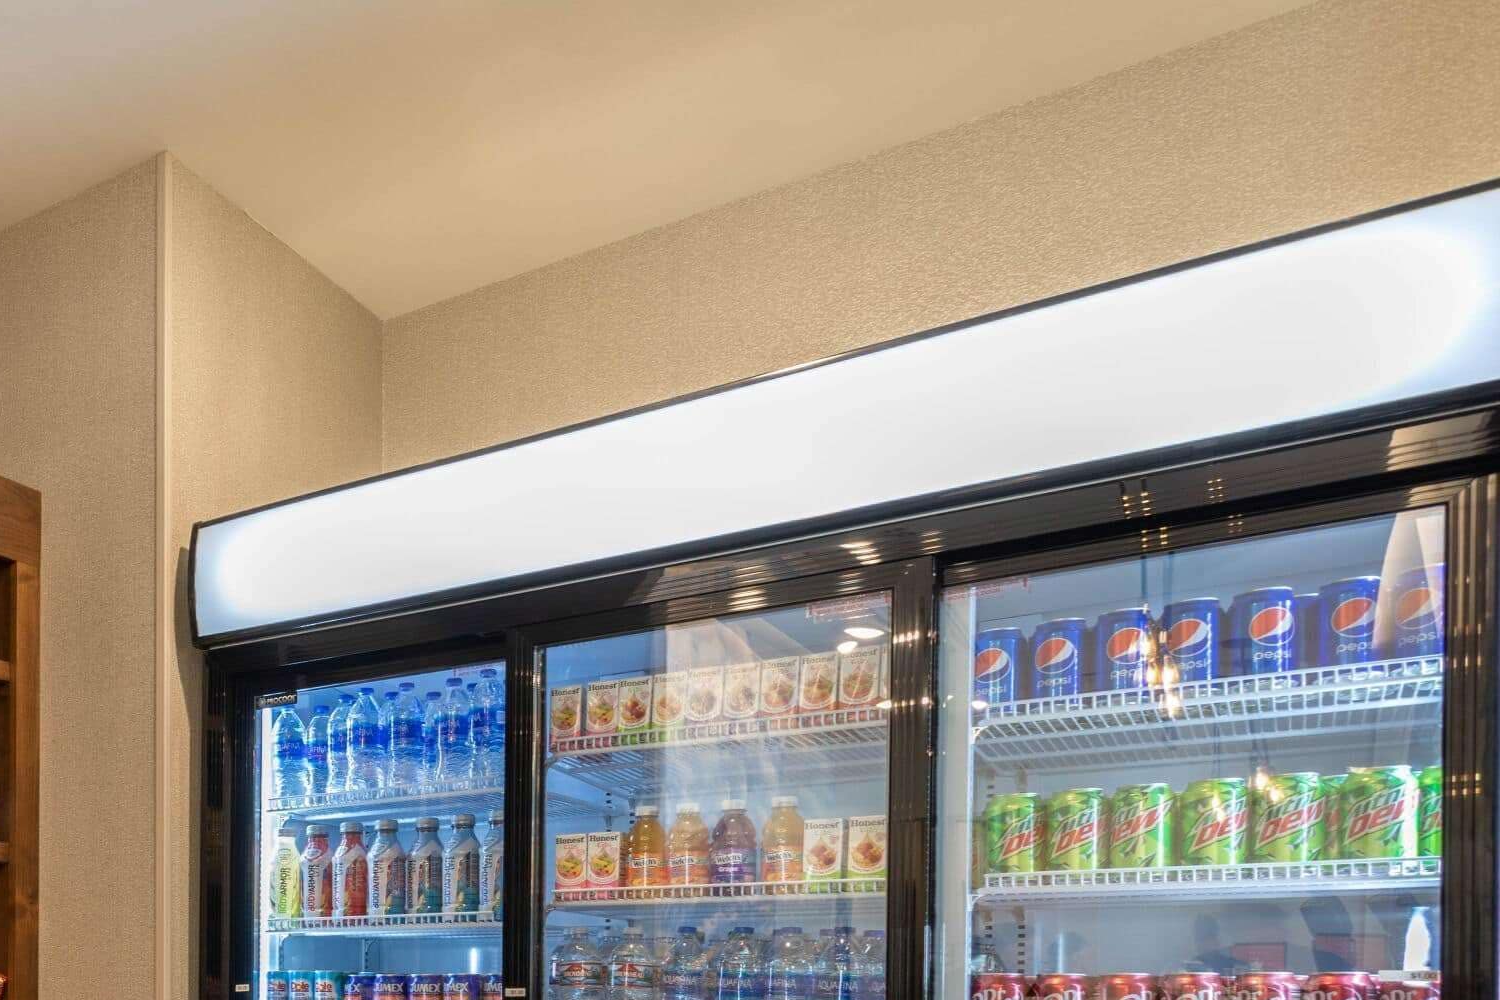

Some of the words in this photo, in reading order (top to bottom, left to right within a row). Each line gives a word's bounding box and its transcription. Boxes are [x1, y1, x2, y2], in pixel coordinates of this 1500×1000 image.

[1252, 649, 1292, 661] pepsi
[1178, 659, 1208, 671] epsi
[588, 682, 618, 692] Honest
[619, 678, 651, 688] Honest
[1036, 676, 1073, 690] pepsi
[551, 688, 580, 697] Honest
[804, 821, 838, 831] Honest
[555, 836, 584, 845] Honest
[589, 834, 619, 842] Honest
[374, 983, 403, 992] JUMEX
[411, 983, 441, 993] JUMEX
